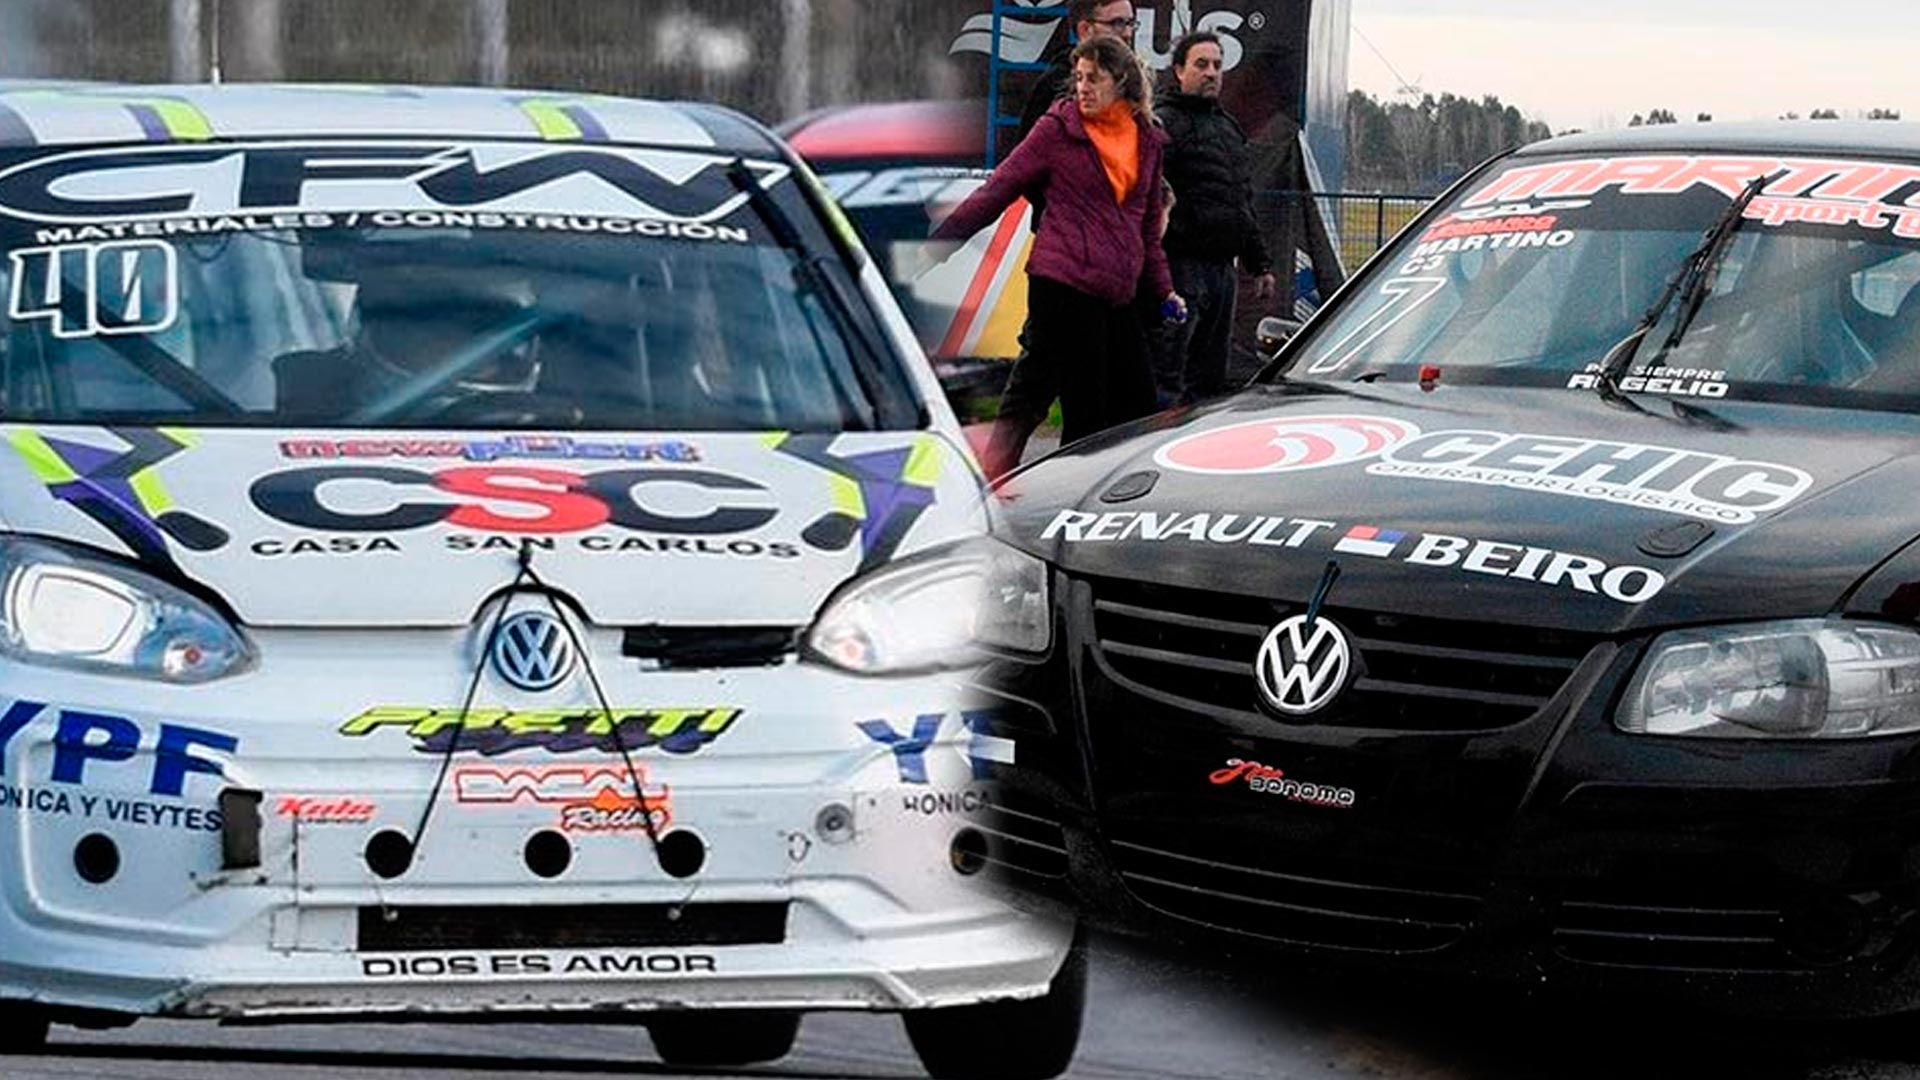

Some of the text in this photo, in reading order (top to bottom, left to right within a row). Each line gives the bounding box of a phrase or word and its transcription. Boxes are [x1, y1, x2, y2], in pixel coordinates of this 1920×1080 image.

[36, 213, 330, 243] MATERIALES
[372, 211, 750, 242] CONSTRUCCIÓN
[1742, 195, 1890, 227] sport
[1412, 230, 1575, 256] MARTINO
[1400, 254, 1446, 275] C3
[8, 239, 178, 338] 40
[1567, 373, 1730, 398] RGELIO
[1632, 365, 1726, 382] SIEMPRE
[1375, 464, 1562, 488] OPERADOR
[1385, 430, 1811, 511] CEHIC
[249, 465, 780, 534] CSC
[250, 535, 800, 559] CASA SAN CARLOS
[1040, 509, 1666, 602] RENAULT BEIRO
[494, 611, 573, 690] VW
[1257, 615, 1349, 713] VW
[82, 796, 100, 817] Y
[106, 798, 222, 832] VIEYTES
[362, 954, 717, 976] DIOS ES AMOR
